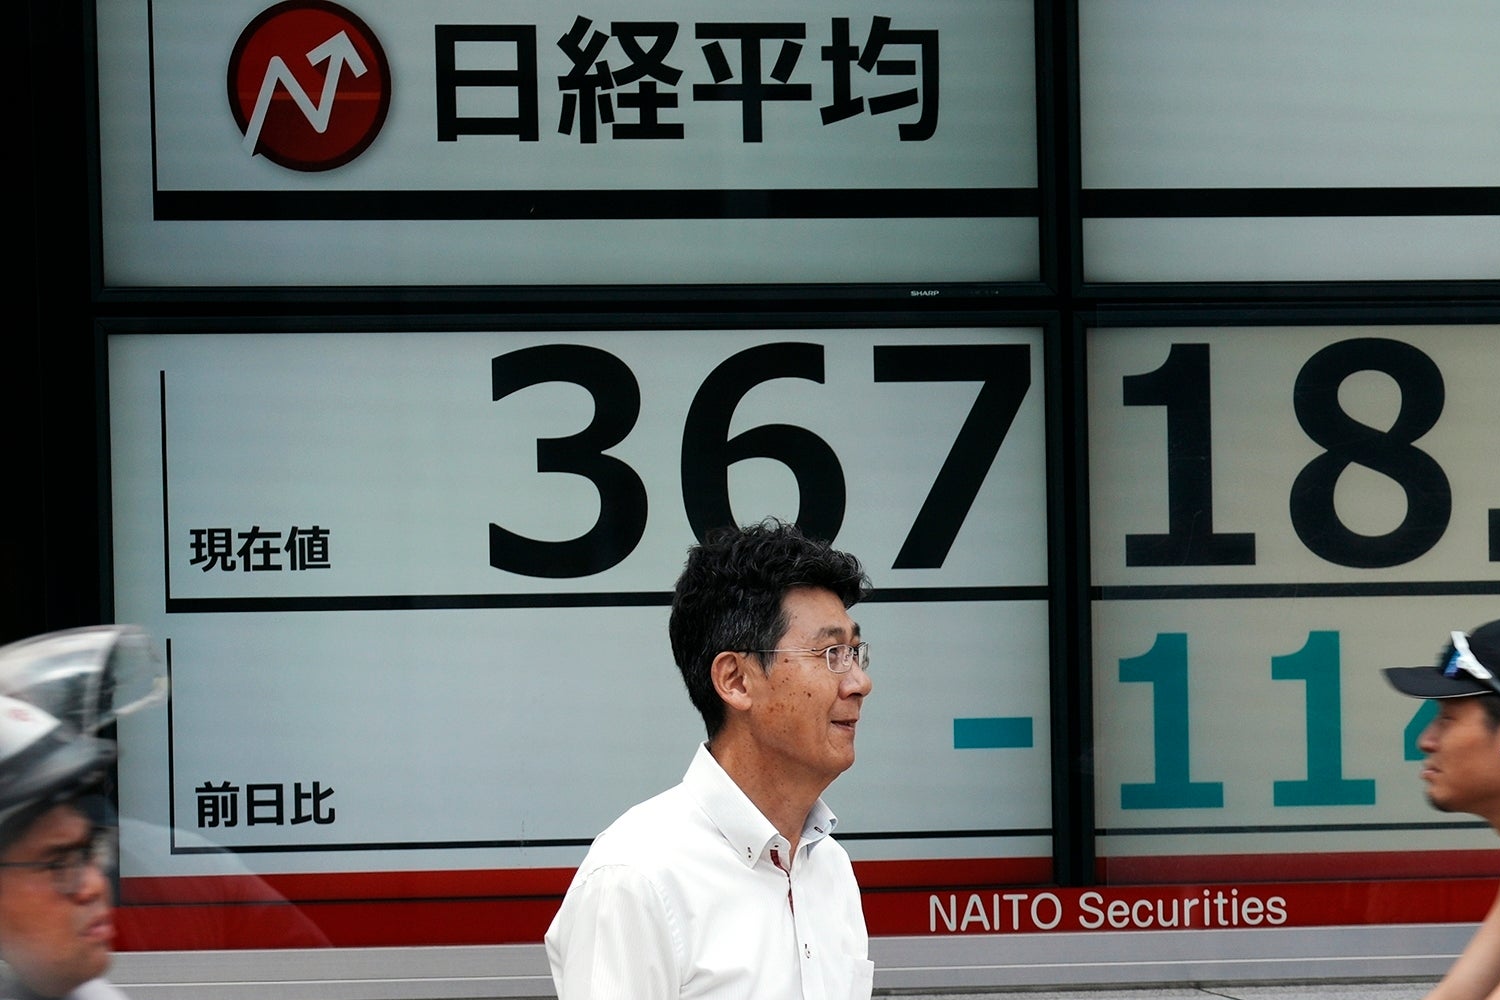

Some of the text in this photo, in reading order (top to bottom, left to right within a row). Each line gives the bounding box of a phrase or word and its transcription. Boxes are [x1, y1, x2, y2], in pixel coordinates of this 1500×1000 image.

[435, 15, 940, 144] 日経平均
[189, 525, 331, 573] 現在値
[195, 780, 336, 829] 前日比
[929, 888, 1288, 932] NAITO Securities
